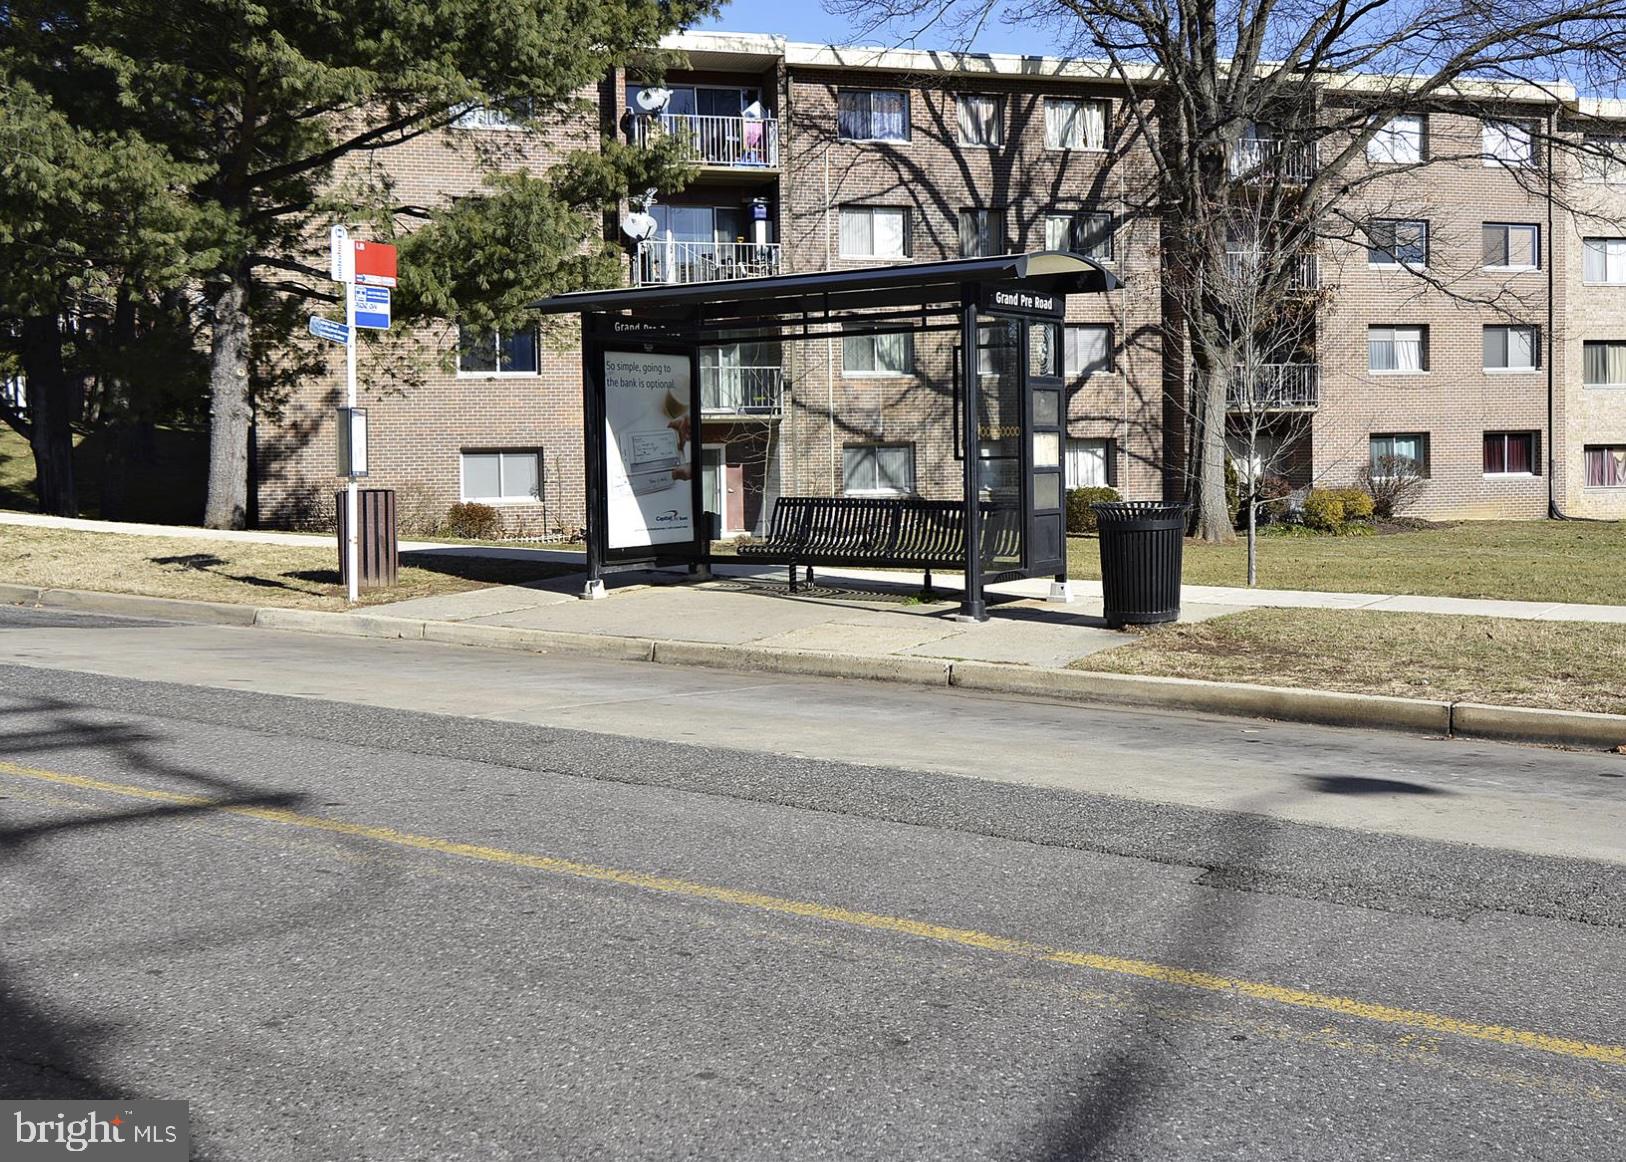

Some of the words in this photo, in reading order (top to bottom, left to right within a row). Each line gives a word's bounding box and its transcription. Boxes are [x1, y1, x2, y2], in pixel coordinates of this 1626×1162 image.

[995, 291, 1019, 305] Grand
[1020, 294, 1033, 308] Pre
[1034, 296, 1053, 310] Road
[606, 360, 616, 371] So
[616, 360, 642, 374] simple,
[642, 362, 663, 375] going
[664, 364, 672, 373] to
[606, 377, 619, 388] the
[620, 377, 637, 389] bank
[638, 378, 645, 389] is
